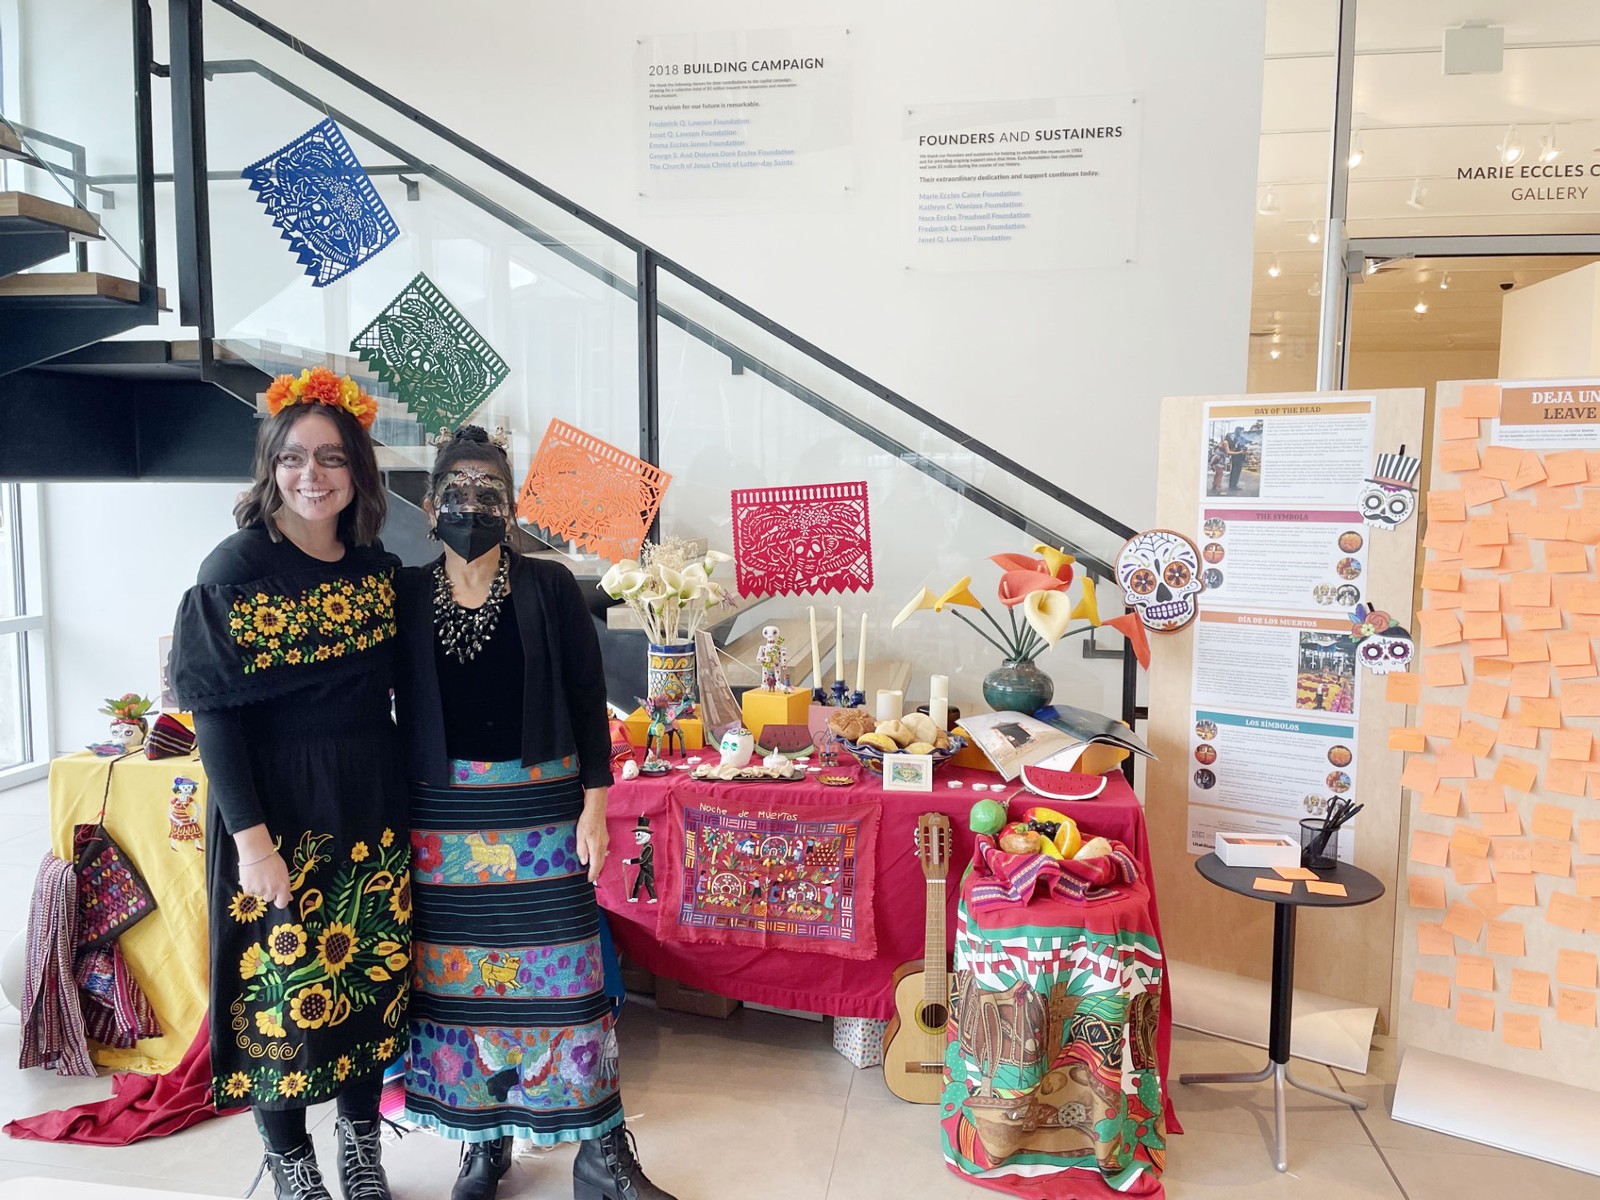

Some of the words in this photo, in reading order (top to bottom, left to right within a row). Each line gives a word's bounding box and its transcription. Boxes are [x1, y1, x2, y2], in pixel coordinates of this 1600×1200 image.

[649, 64, 679, 76] 2018
[683, 62, 747, 74] BUILDING
[752, 58, 824, 72] CAMPAIGN
[919, 133, 995, 146] FOUNDERS
[999, 131, 1030, 143] AND
[1035, 126, 1123, 141] SUSTAINERS
[1458, 166, 1514, 180] MARIE
[1521, 164, 1584, 178] ECCLES
[1511, 186, 1588, 201] GALLERY
[1531, 391, 1574, 404] DEJA
[1544, 407, 1596, 419] LEAVE
[1238, 615, 1251, 623] DÍA
[1280, 619, 1317, 627] MUERTOS
[1260, 719, 1299, 730] SÍMBOLOS
[700, 802, 727, 815] Noche
